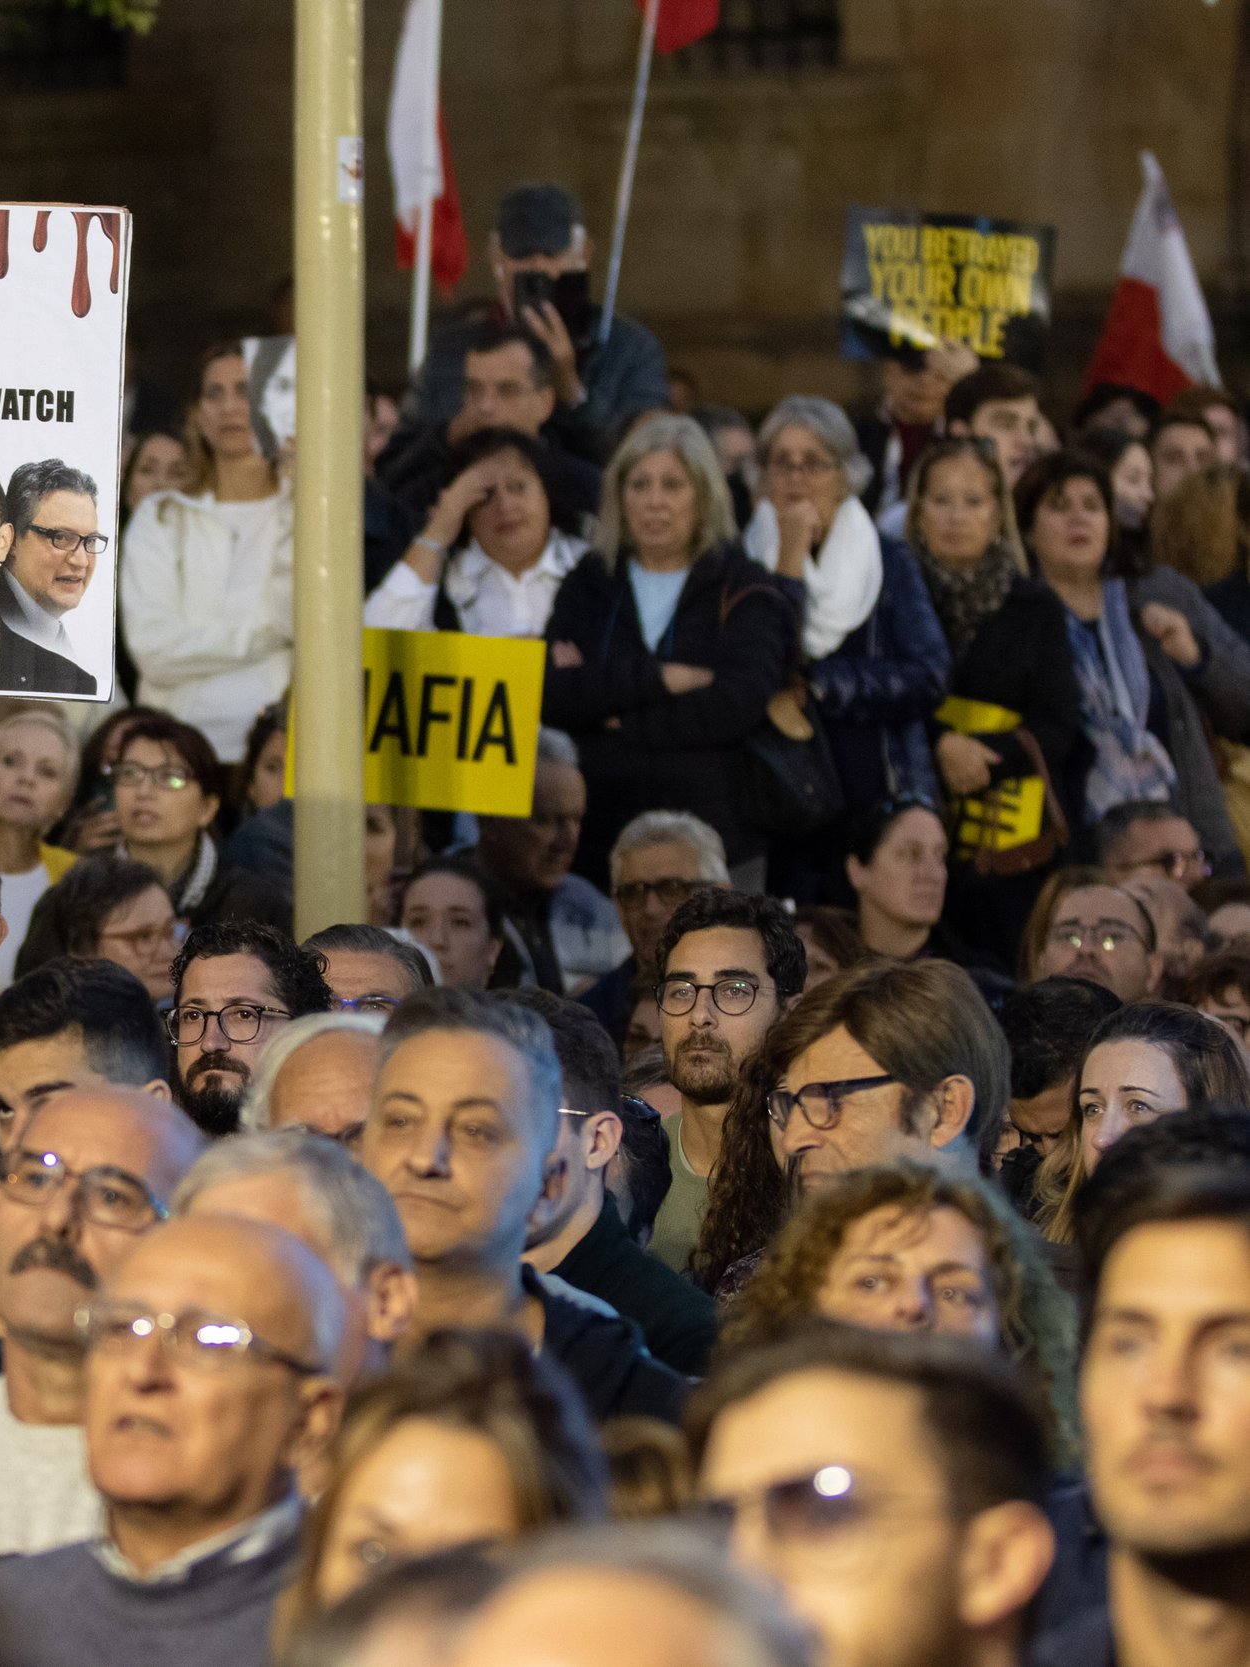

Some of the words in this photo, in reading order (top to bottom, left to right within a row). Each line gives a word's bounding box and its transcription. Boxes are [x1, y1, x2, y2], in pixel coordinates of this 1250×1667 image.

[862, 224, 919, 261] YOU
[921, 225, 1039, 275] BETRAYED
[869, 260, 957, 307] YOUR
[959, 266, 1032, 317] OWN
[364, 667, 518, 767] AFIA
